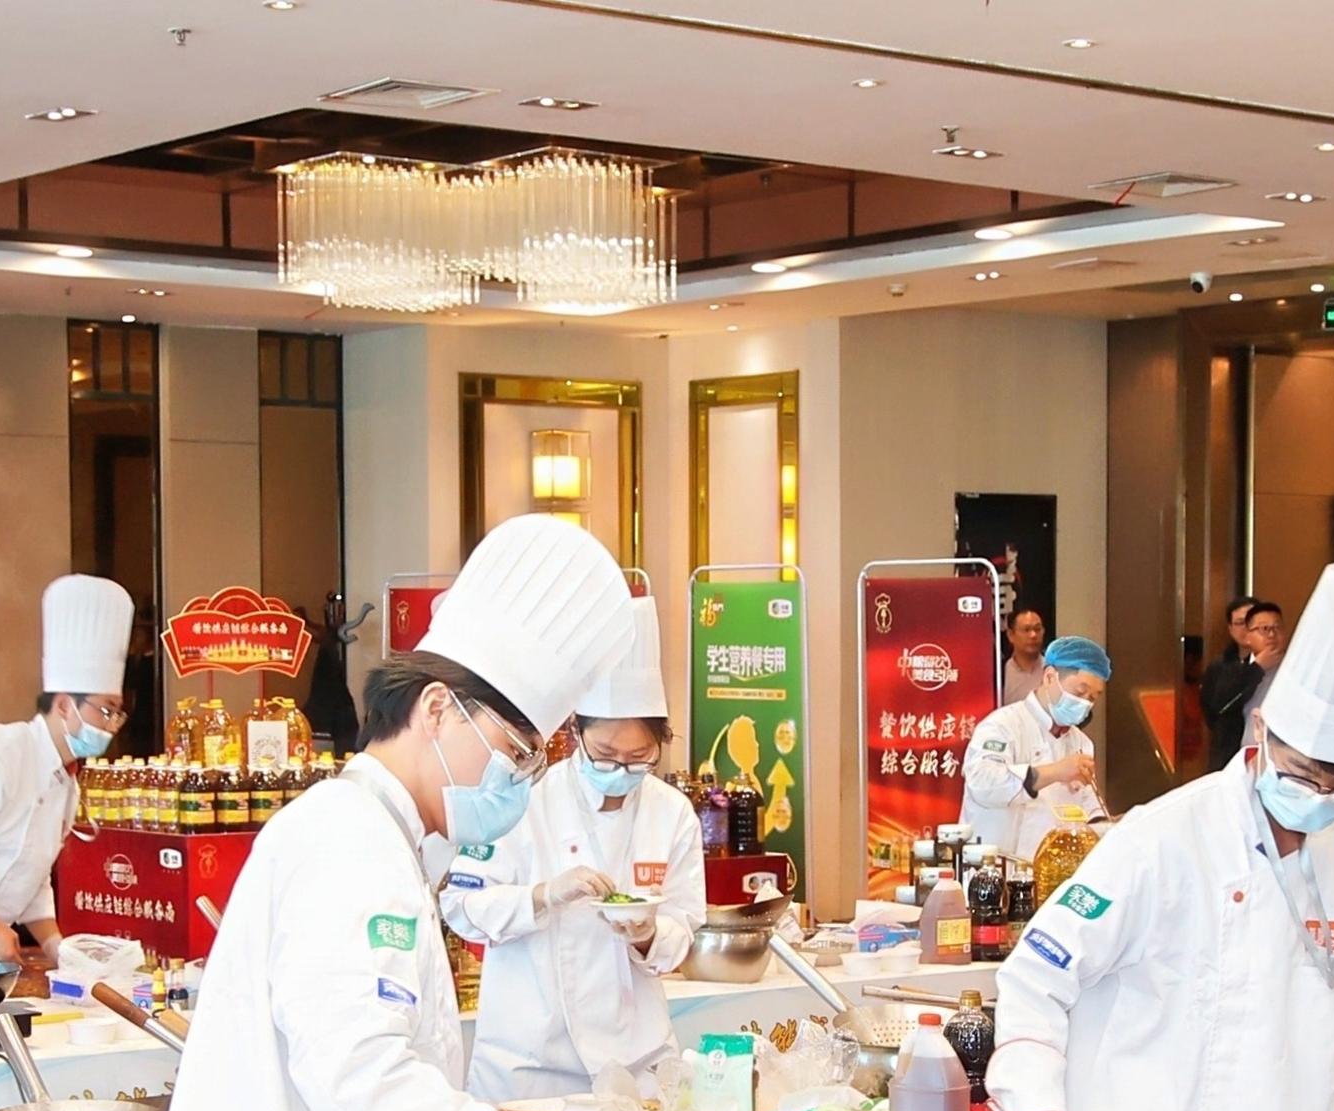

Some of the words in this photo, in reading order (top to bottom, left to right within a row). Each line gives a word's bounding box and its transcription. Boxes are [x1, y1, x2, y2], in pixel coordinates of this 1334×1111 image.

[706, 645, 786, 677] 学生营养餐专用
